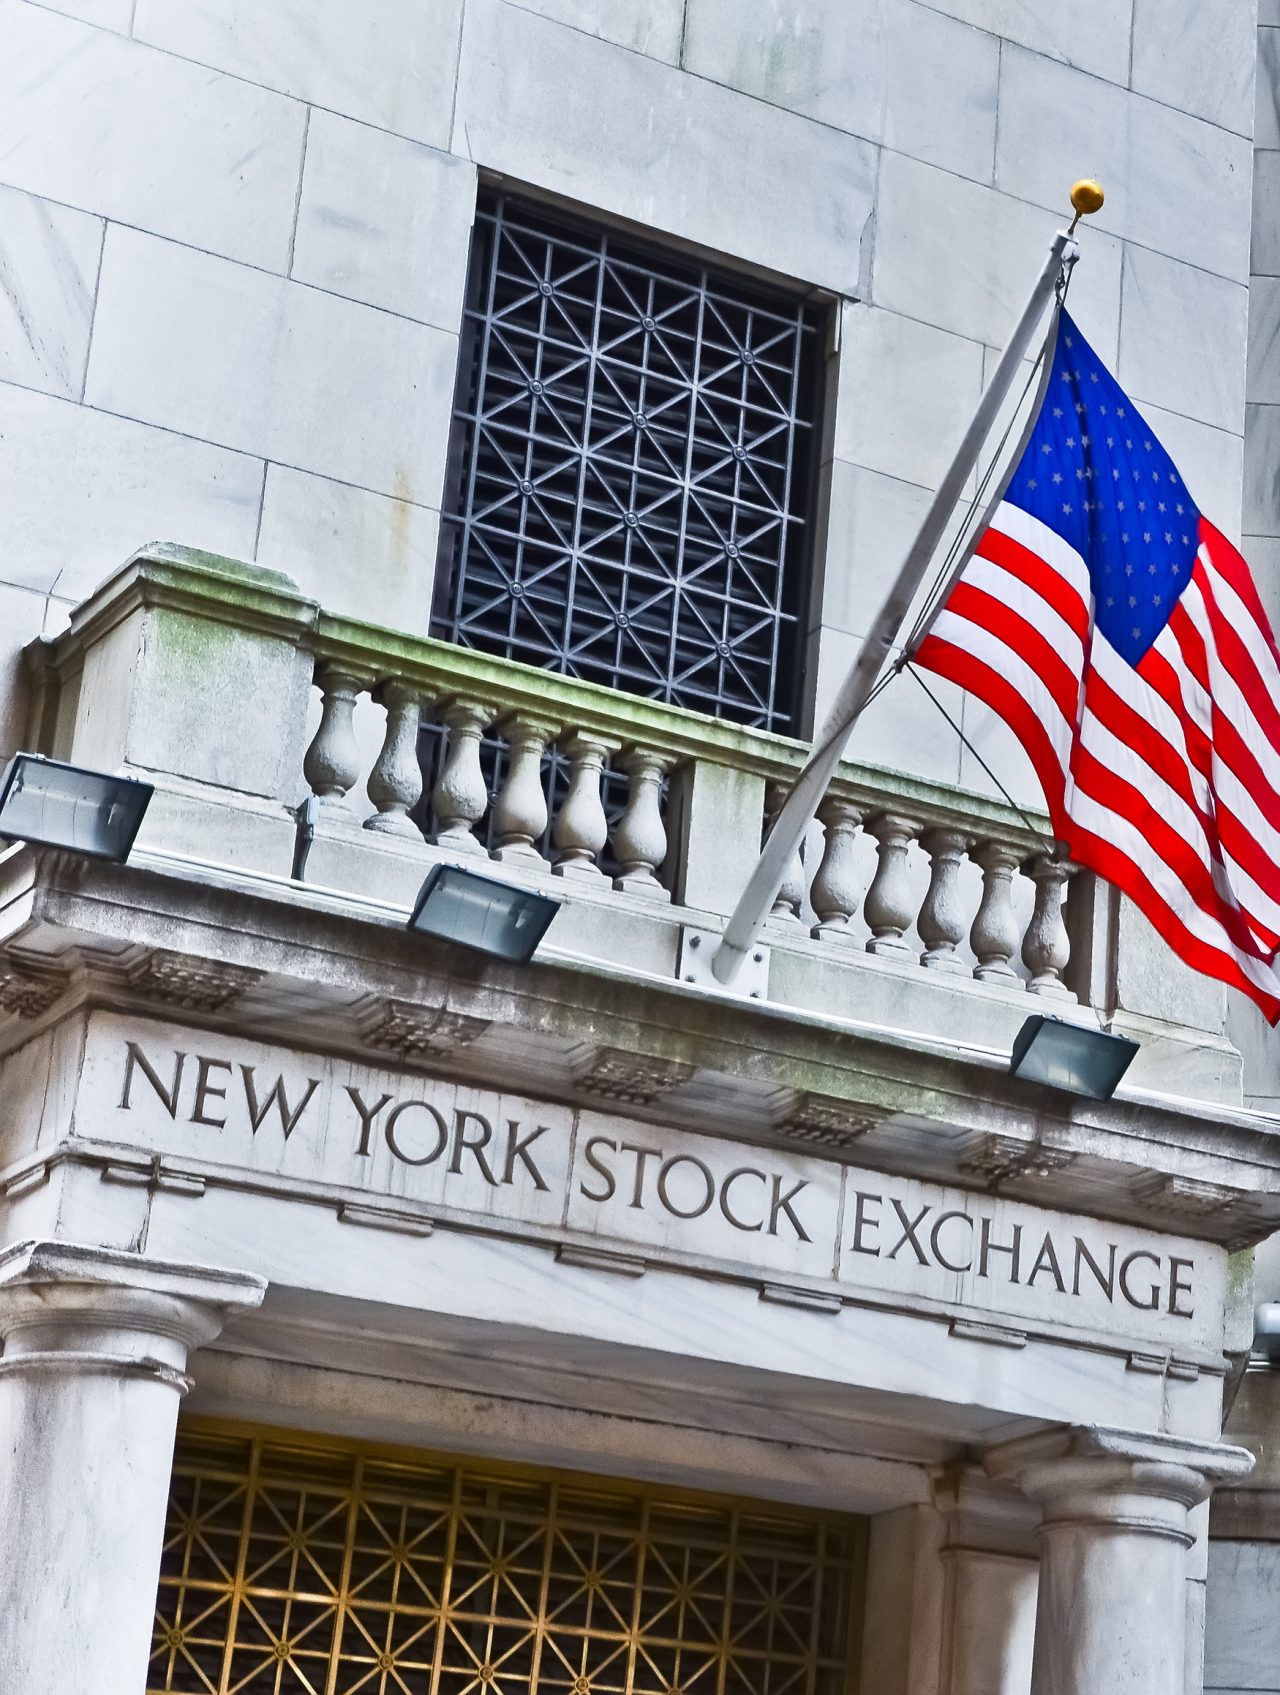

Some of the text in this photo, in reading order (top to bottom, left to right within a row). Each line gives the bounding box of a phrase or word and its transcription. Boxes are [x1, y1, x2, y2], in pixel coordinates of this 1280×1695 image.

[117, 1040, 1195, 1320] NEW YORK STOCK EXCHANGE
